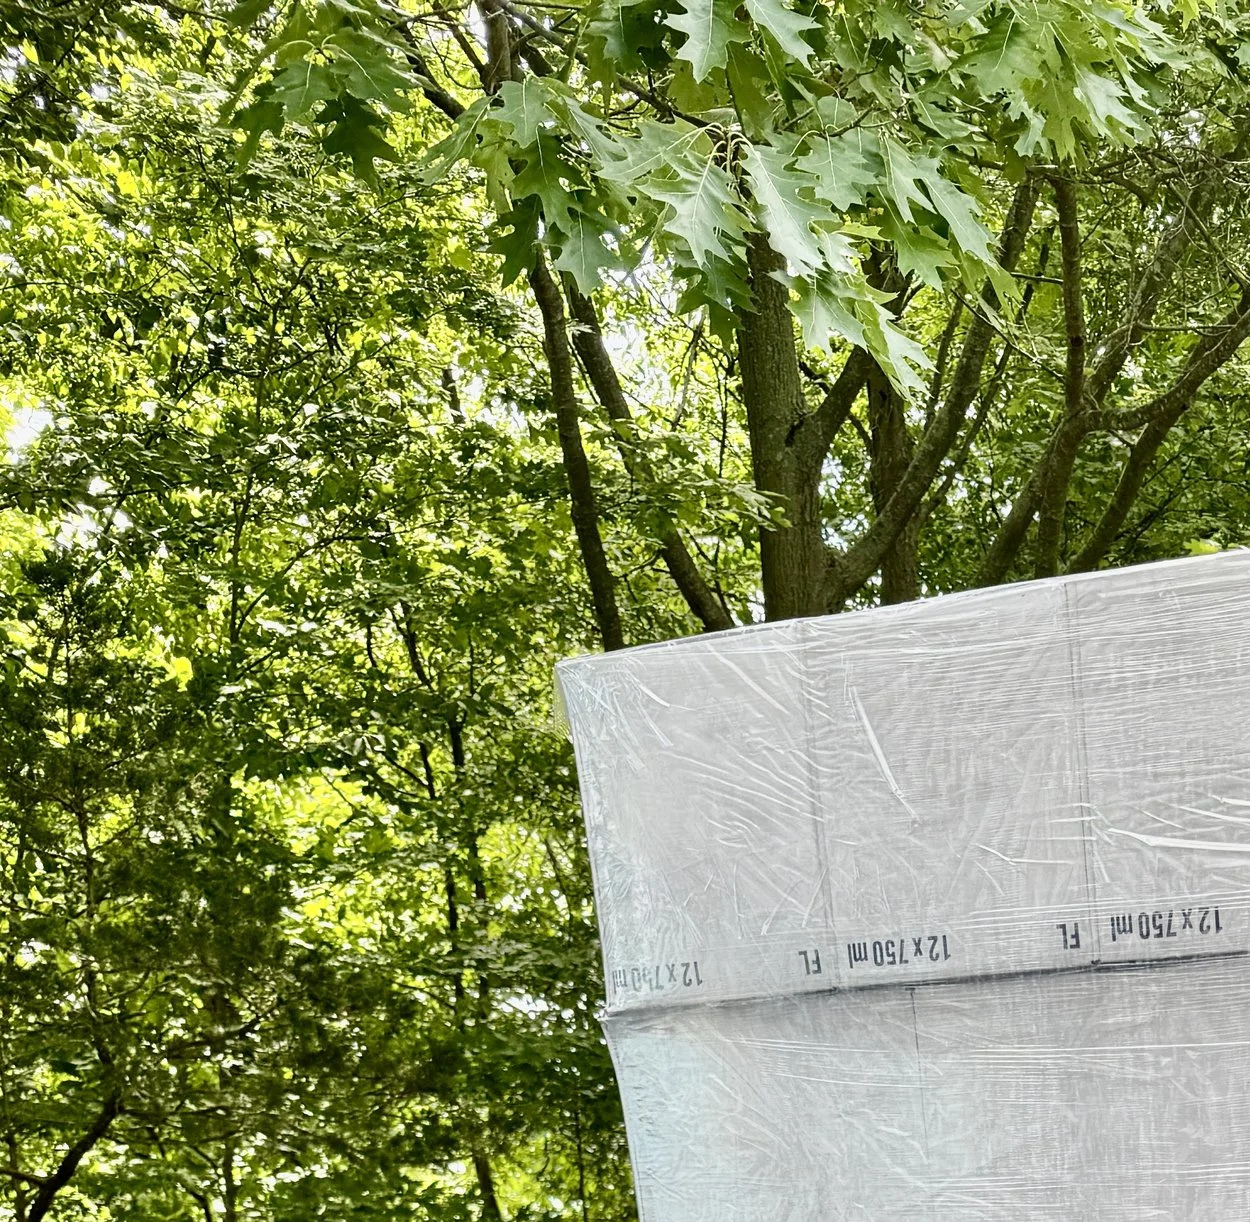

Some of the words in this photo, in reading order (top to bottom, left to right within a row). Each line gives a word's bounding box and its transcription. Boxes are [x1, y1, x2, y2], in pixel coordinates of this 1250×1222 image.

[1110, 913, 1133, 941] ml
[1138, 910, 1177, 939] 750
[1198, 906, 1223, 935] 12
[928, 935, 951, 961] 12
[1056, 923, 1081, 950] FL
[799, 949, 821, 975] FL
[847, 942, 868, 969] ml
[873, 939, 909, 966] 750
[681, 961, 702, 987] 12
